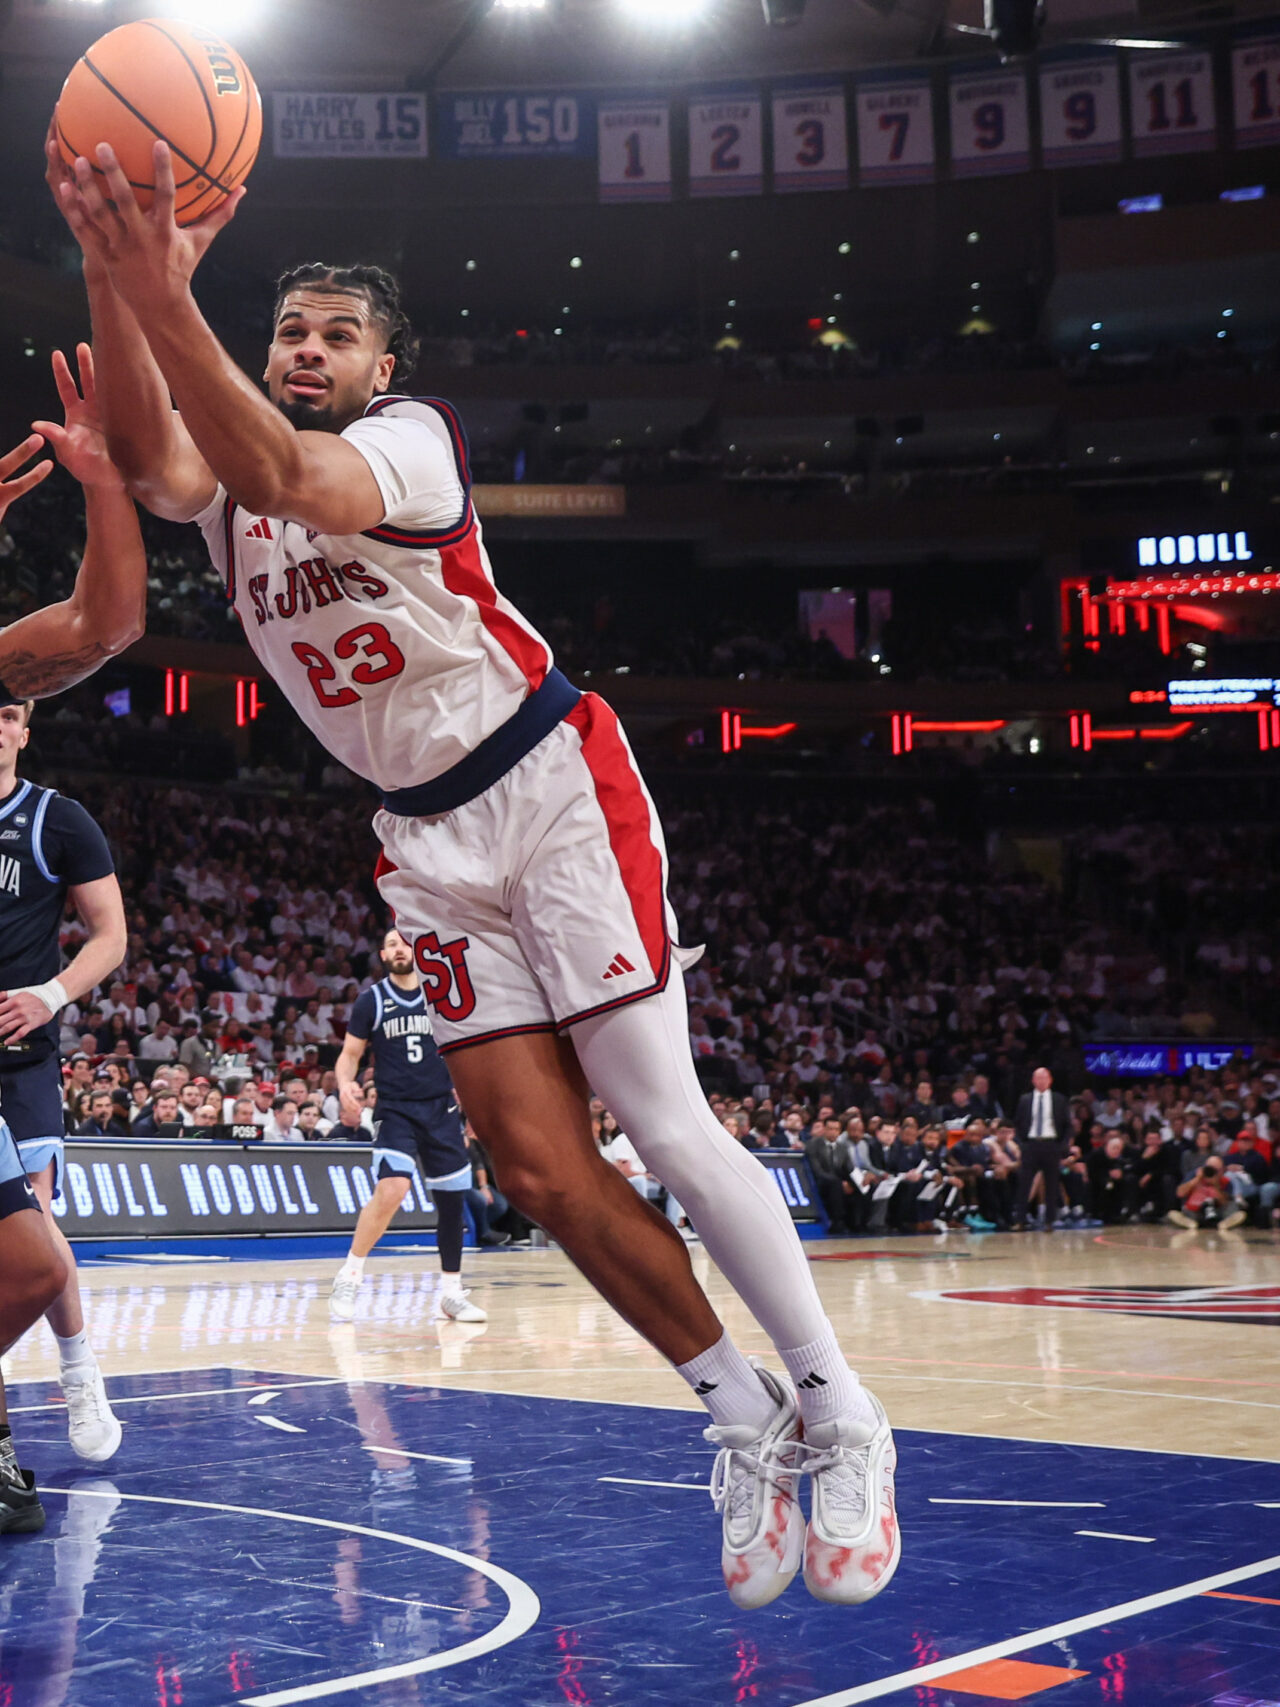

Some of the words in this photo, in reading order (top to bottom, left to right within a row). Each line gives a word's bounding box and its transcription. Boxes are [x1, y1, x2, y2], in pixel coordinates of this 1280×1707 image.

[285, 97, 357, 118] HARRY
[1063, 90, 1097, 140] 9
[1147, 77, 1198, 131] 11
[1249, 68, 1280, 121] 1
[280, 118, 365, 140] STYLES
[375, 97, 420, 140] 15
[503, 97, 579, 143] 150
[795, 118, 826, 166] 3
[878, 112, 910, 161] 7
[973, 102, 1005, 151] 9
[625, 131, 645, 178] 1
[710, 123, 741, 171] 2
[514, 492, 563, 508] SUITE
[1138, 531, 1252, 566] NOBULL
[290, 622, 406, 708] 23
[405, 1035, 424, 1063] 5
[232, 1125, 258, 1139] POSS
[50, 1163, 168, 1216] BULL
[179, 1164, 319, 1216] NOBULL
